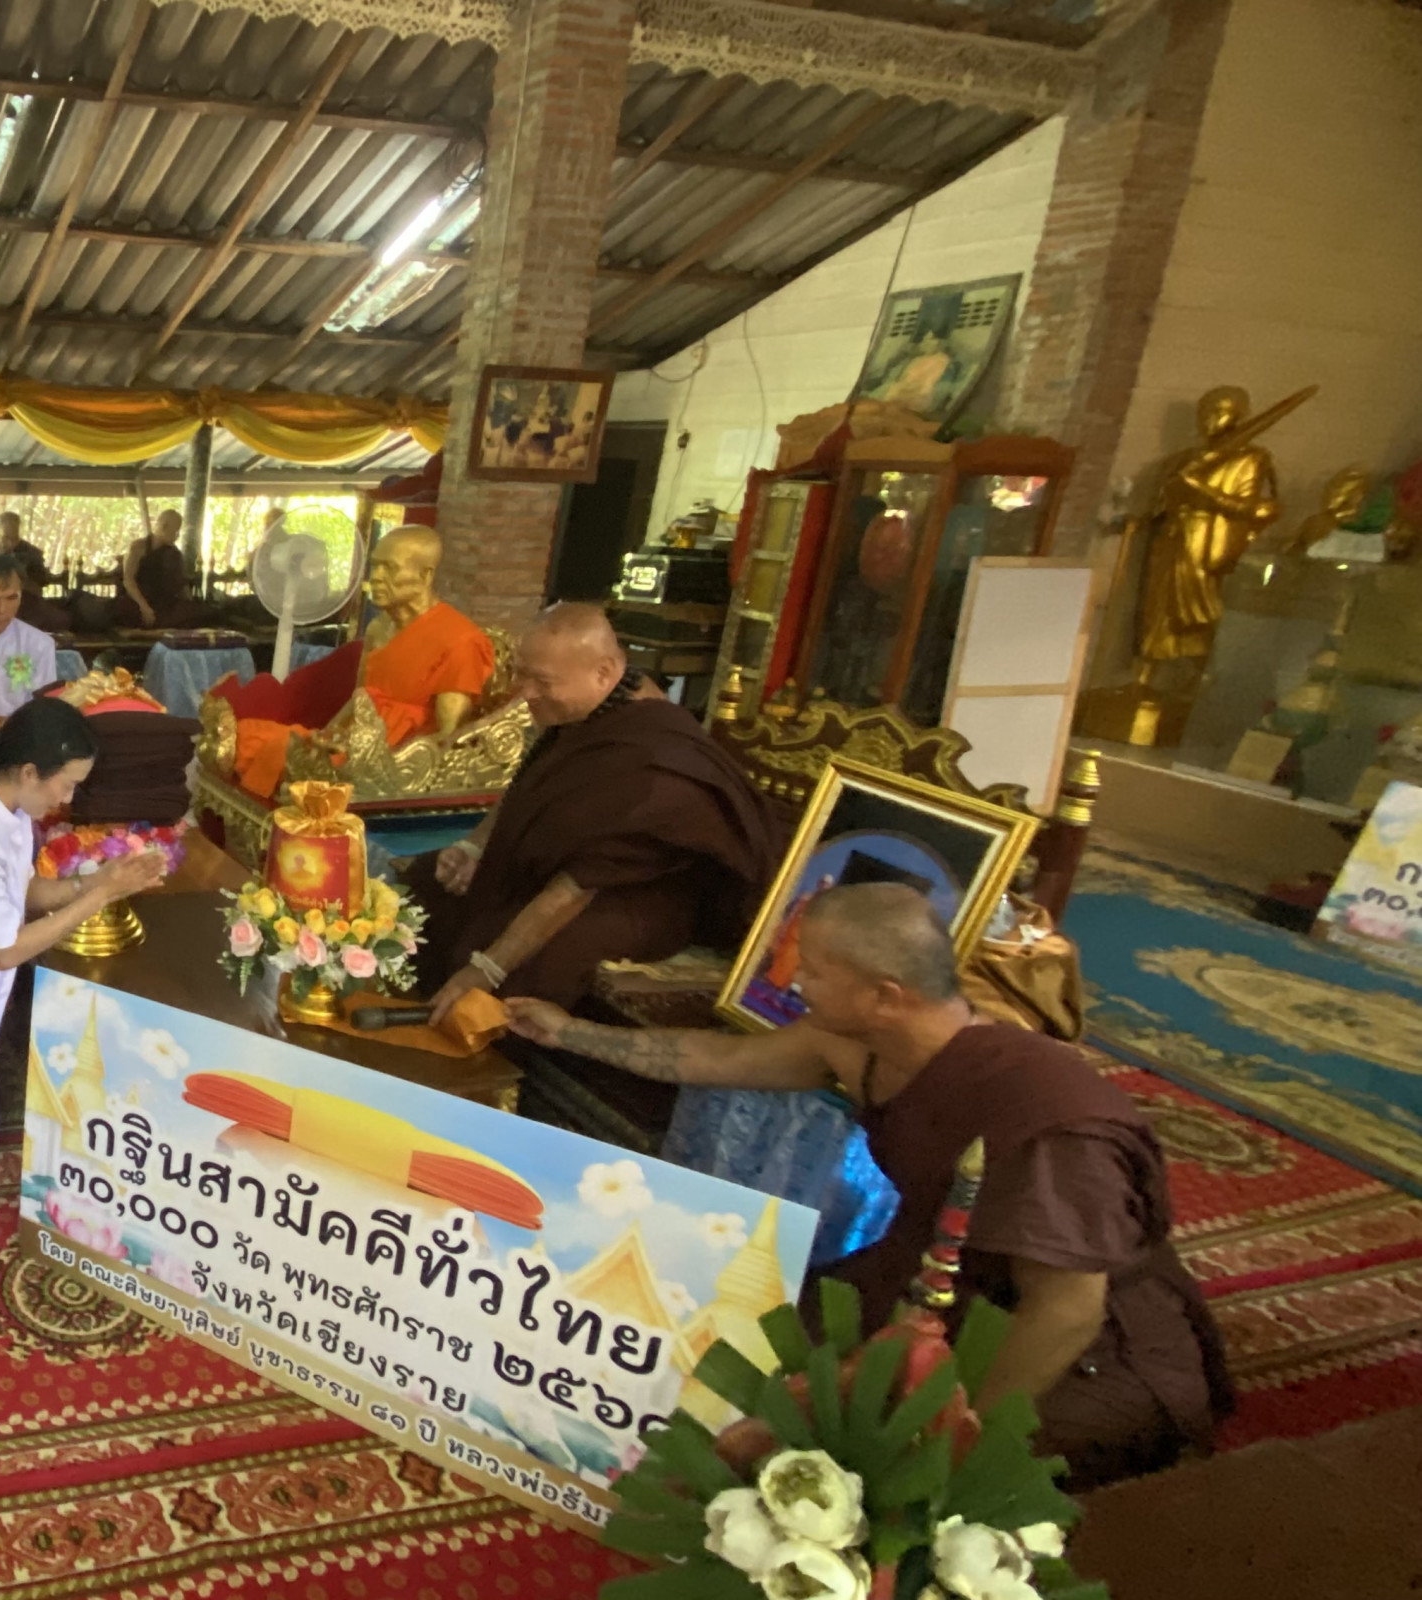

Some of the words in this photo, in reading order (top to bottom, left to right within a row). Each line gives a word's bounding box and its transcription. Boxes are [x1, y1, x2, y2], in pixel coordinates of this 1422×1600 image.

[59, 1162, 219, 1249] ๓๐,๐๐๐
[233, 1231, 271, 1275] วัด
[282, 1261, 473, 1363] พุทธศักราช
[87, 1112, 663, 1376] กฐินสามัคคีทั่วไทย
[191, 1260, 467, 1413] จังหวัดเชียงราย
[39, 1231, 74, 1264] โดย
[81, 1259, 242, 1347] คณะศิษยานุศิษย์
[250, 1341, 360, 1408] บูชาธรรม
[419, 1417, 438, 1443] ปี
[448, 1437, 613, 1522] หลวงพ่อธัม
